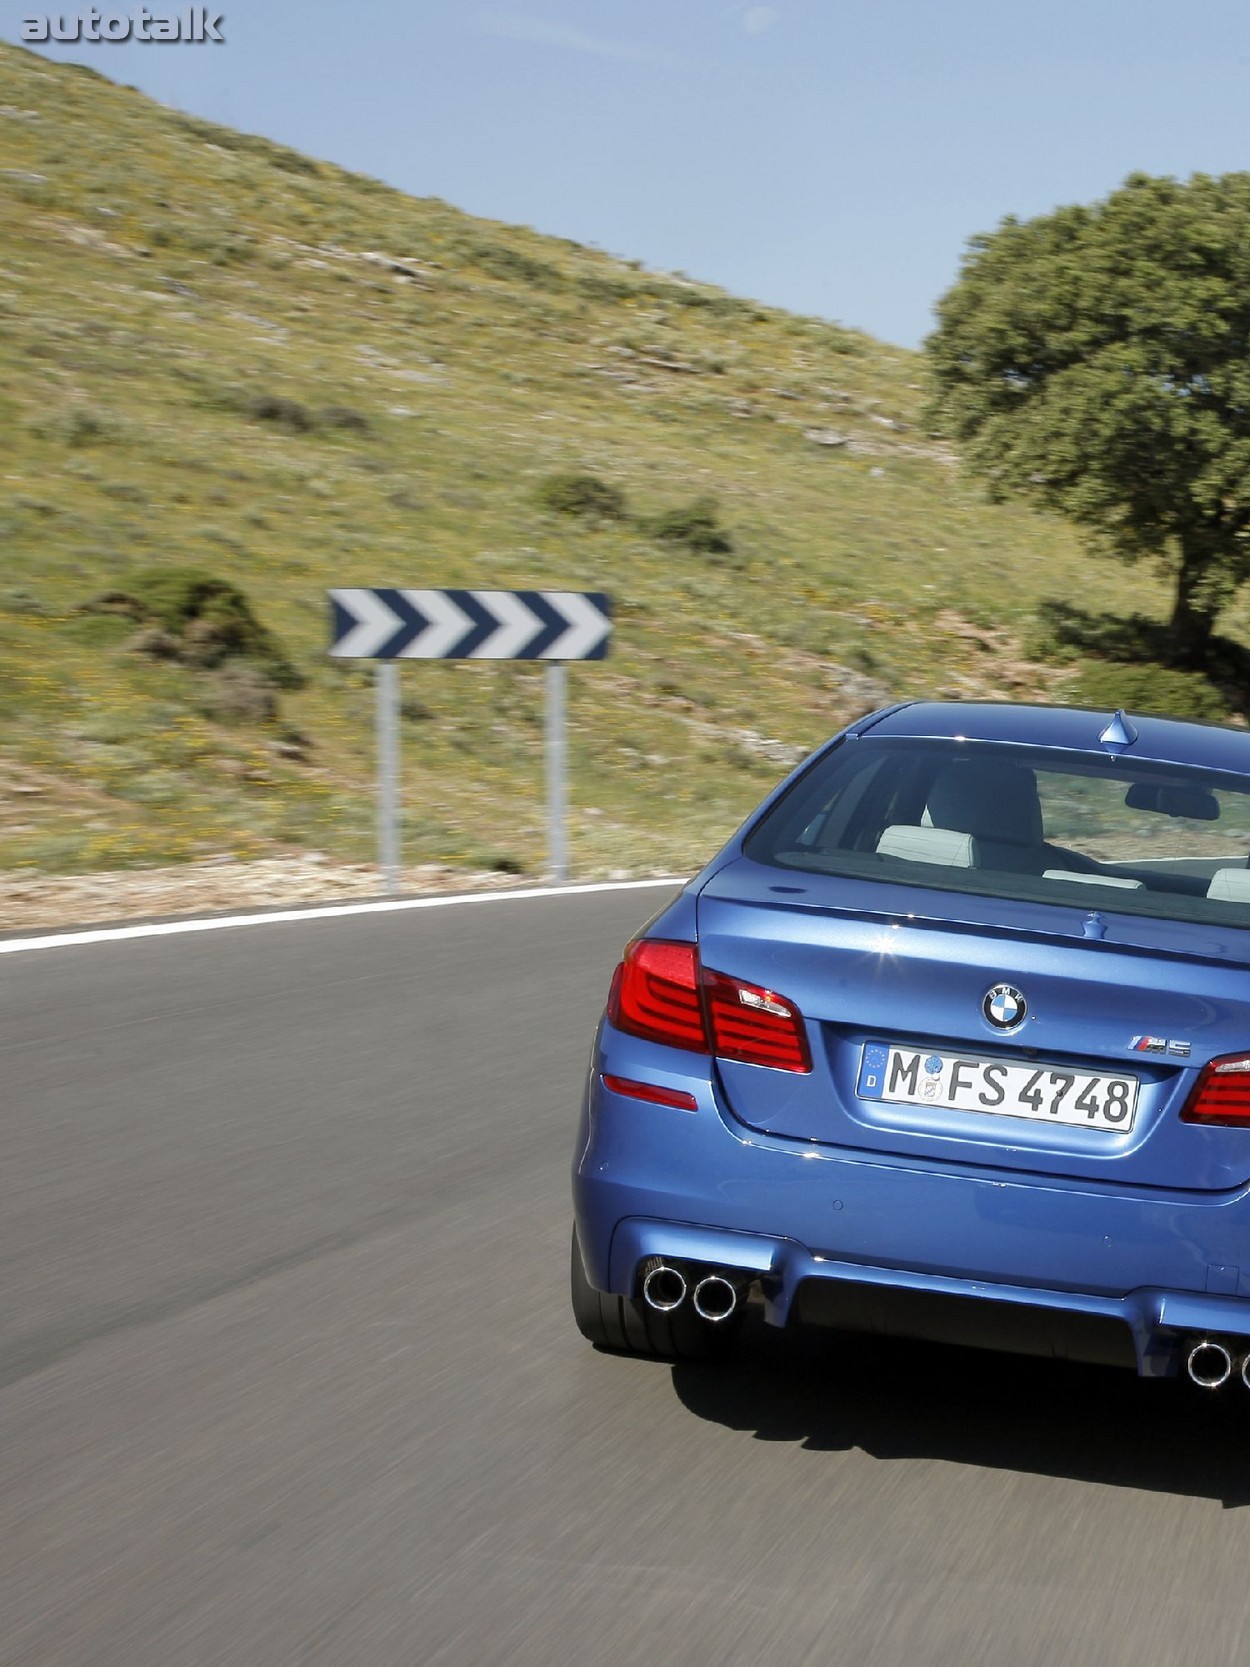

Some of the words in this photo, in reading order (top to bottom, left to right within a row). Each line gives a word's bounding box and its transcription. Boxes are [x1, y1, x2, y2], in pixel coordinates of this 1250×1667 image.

[989, 986, 1024, 1002] BMW
[1127, 1035, 1191, 1058] M5
[866, 1075, 877, 1088] D
[889, 1051, 921, 1096] M
[948, 1060, 1008, 1107] FS
[1018, 1069, 1130, 1123] 4748
